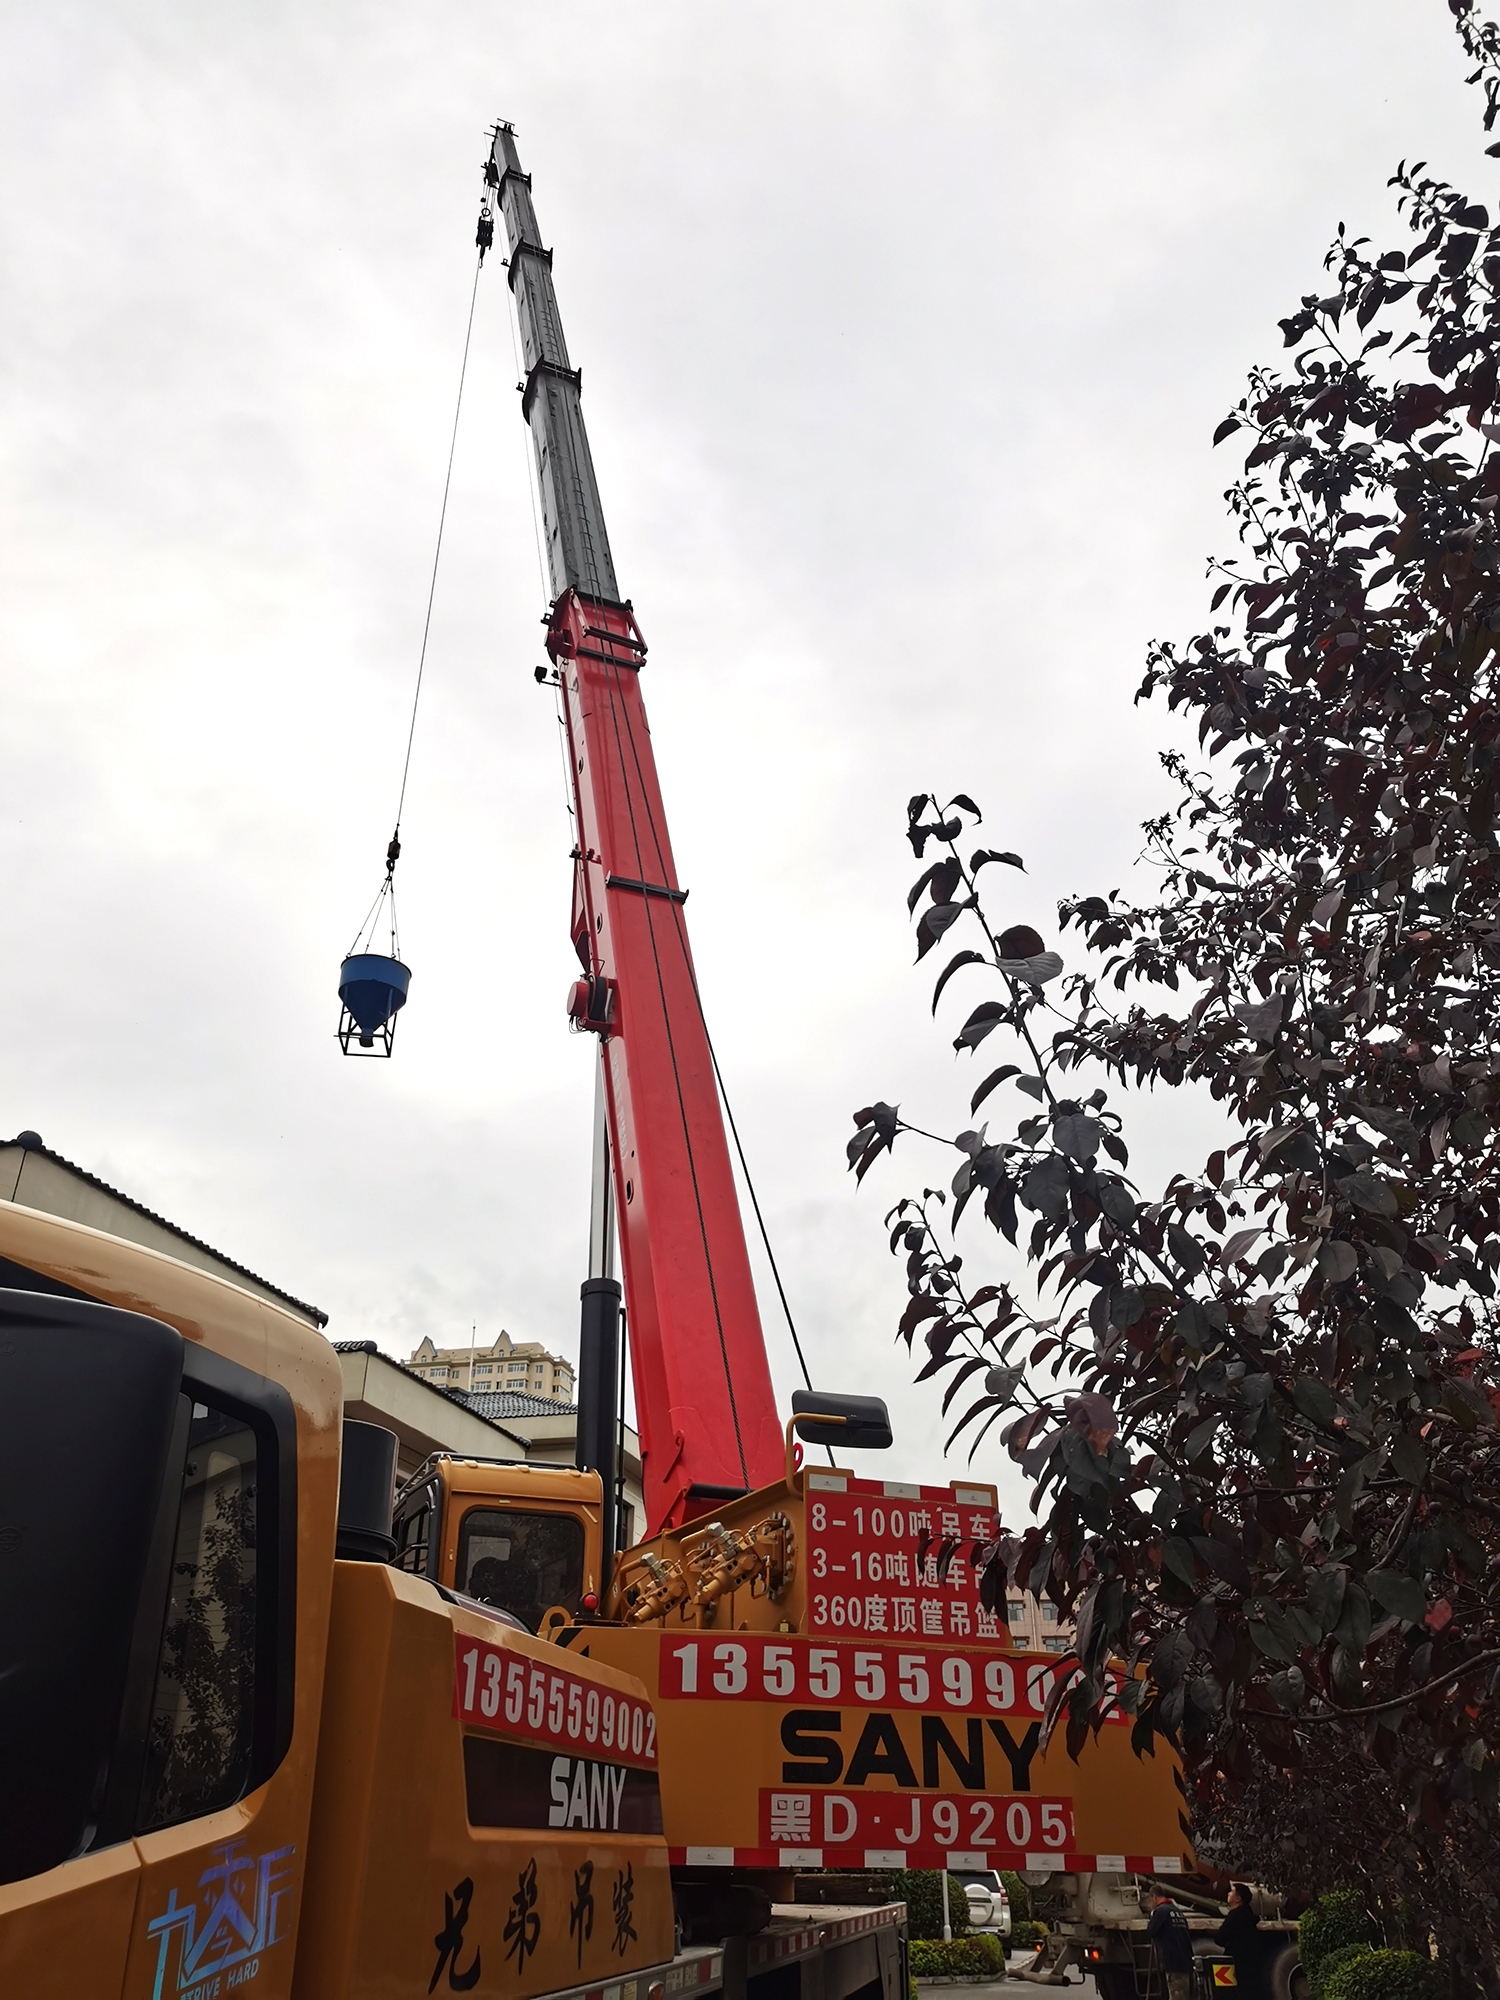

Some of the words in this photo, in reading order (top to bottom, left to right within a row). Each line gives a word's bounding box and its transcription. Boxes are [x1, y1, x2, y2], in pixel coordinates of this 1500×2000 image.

[812, 1548, 987, 1591] 3-16吨随车
[463, 1649, 657, 1758] 13555599002
[780, 1709, 1043, 1791] SANY
[549, 1756, 627, 1830] SANY
[428, 1857, 638, 1996] 兄弟吊装
[226, 1959, 259, 1990] HARD
